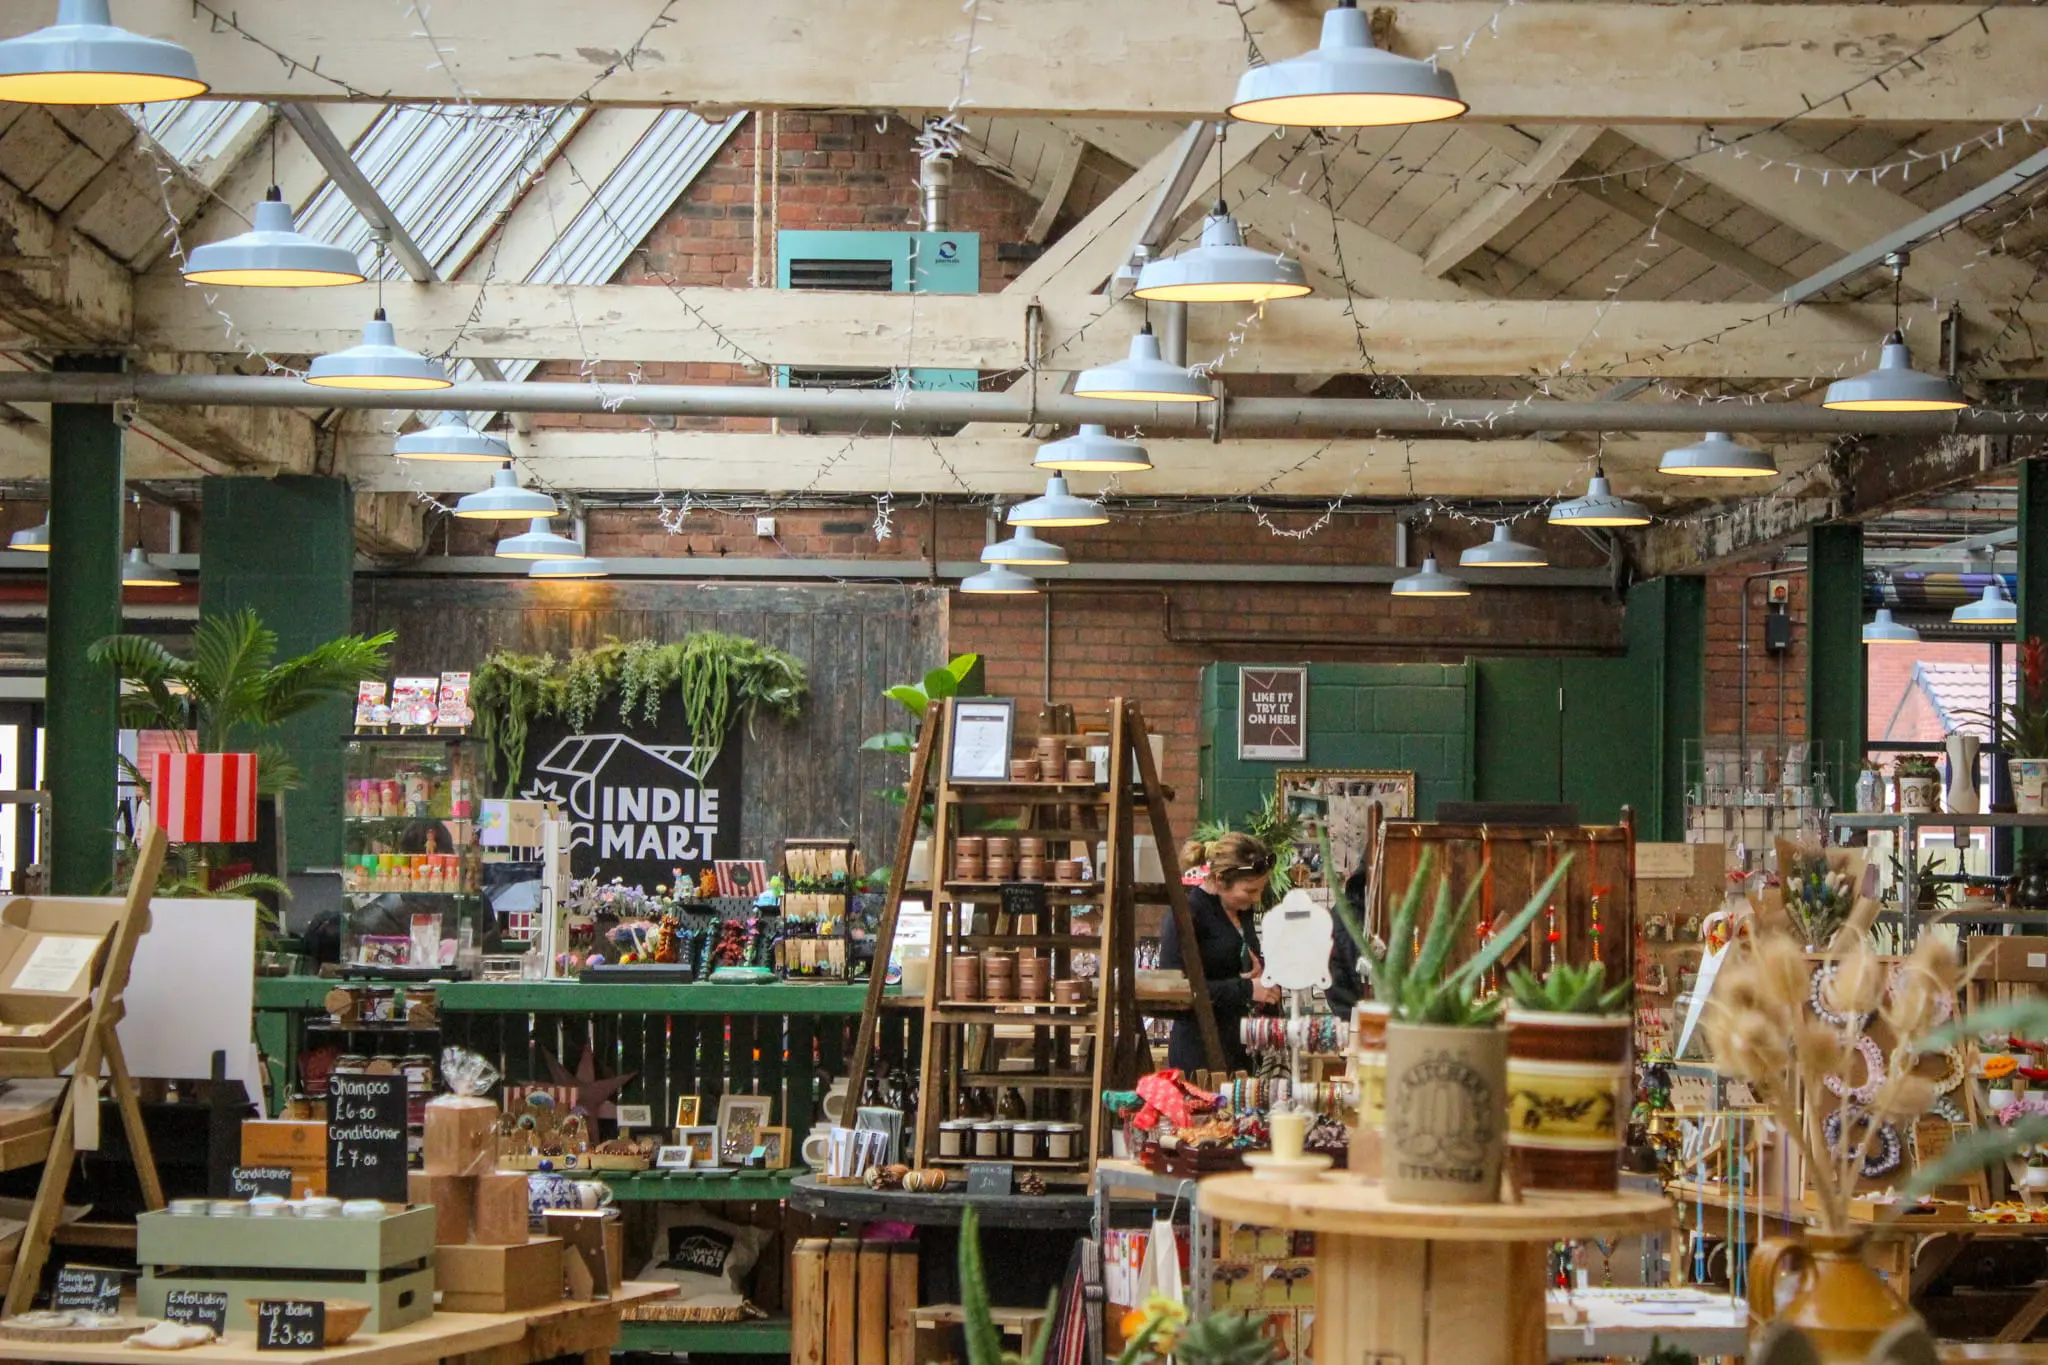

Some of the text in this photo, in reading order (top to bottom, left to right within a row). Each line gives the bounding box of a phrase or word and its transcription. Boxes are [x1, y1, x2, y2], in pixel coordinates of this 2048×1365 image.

[1252, 692, 1293, 703] LIKE IT?
[1256, 703, 1290, 714] TRY IT
[1248, 714, 1297, 725] ON HERE
[602, 786, 719, 823] INDIE
[601, 823, 718, 861] MART
[330, 1076, 390, 1101] Shampoo
[329, 1124, 401, 1140] Conditioner
[232, 1167, 292, 1180] Conditioner
[260, 1302, 281, 1317] Lip
[268, 1316, 314, 1345] £3.50
